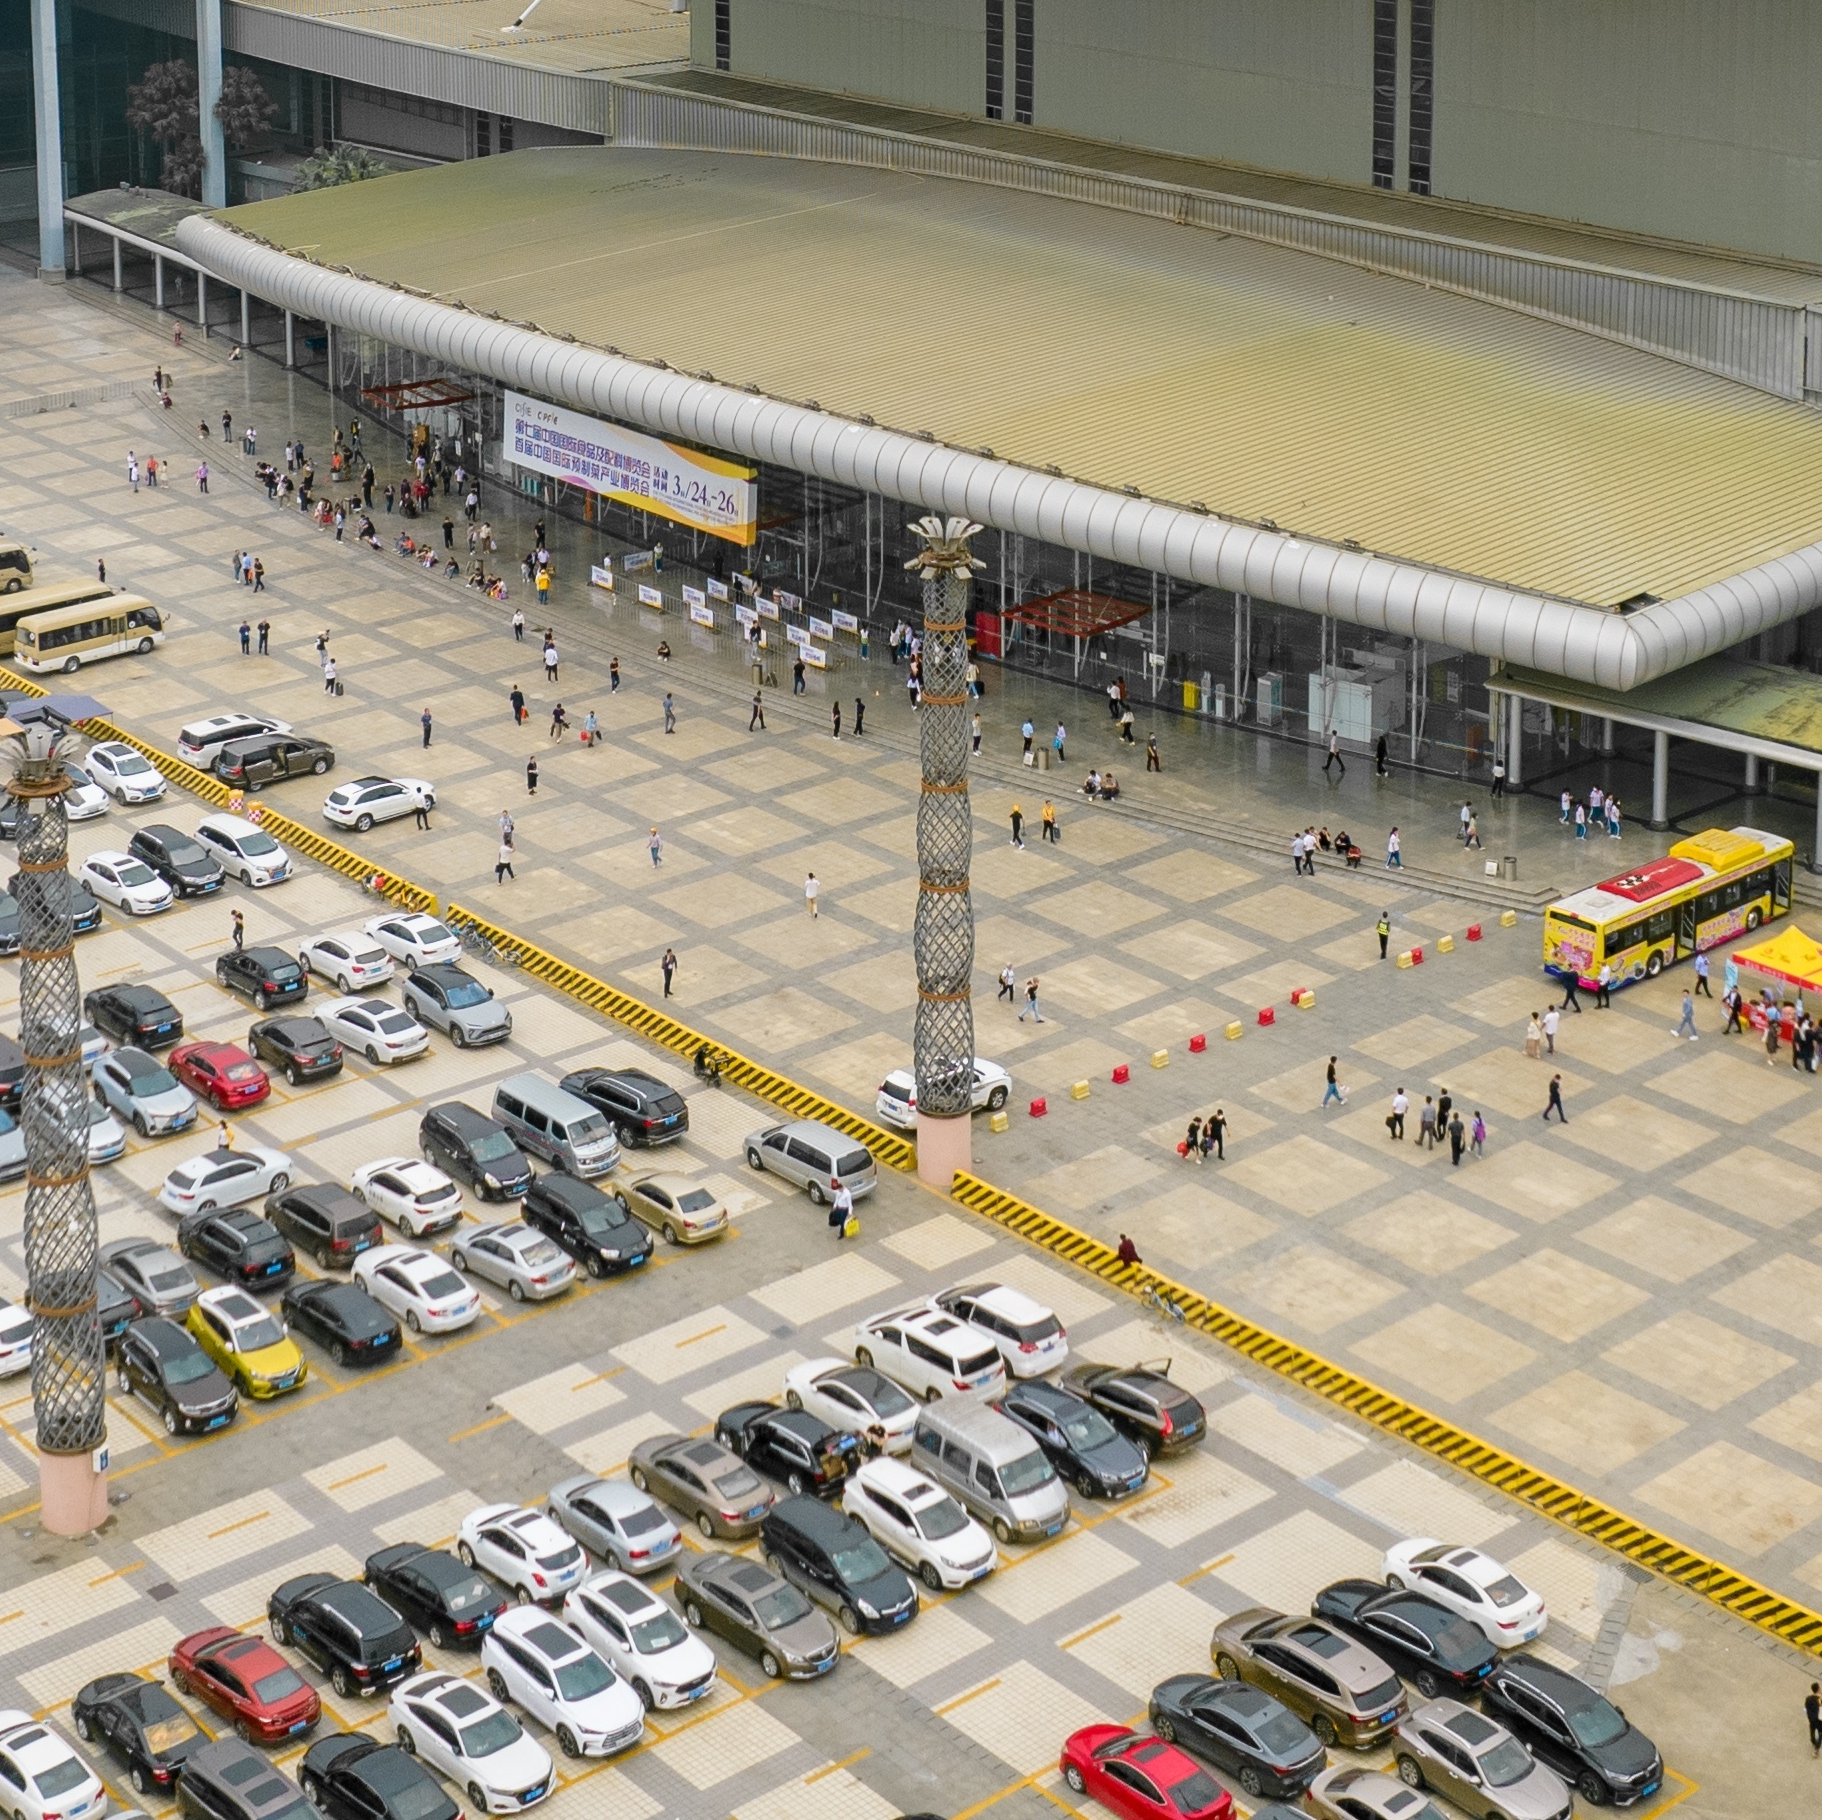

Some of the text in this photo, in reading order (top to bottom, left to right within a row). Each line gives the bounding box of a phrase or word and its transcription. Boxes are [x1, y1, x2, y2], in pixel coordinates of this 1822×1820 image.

[515, 418, 651, 479] 第七届中国国际食品及配料博览会
[515, 436, 650, 498] 首届中国国际预制菜产业博览会
